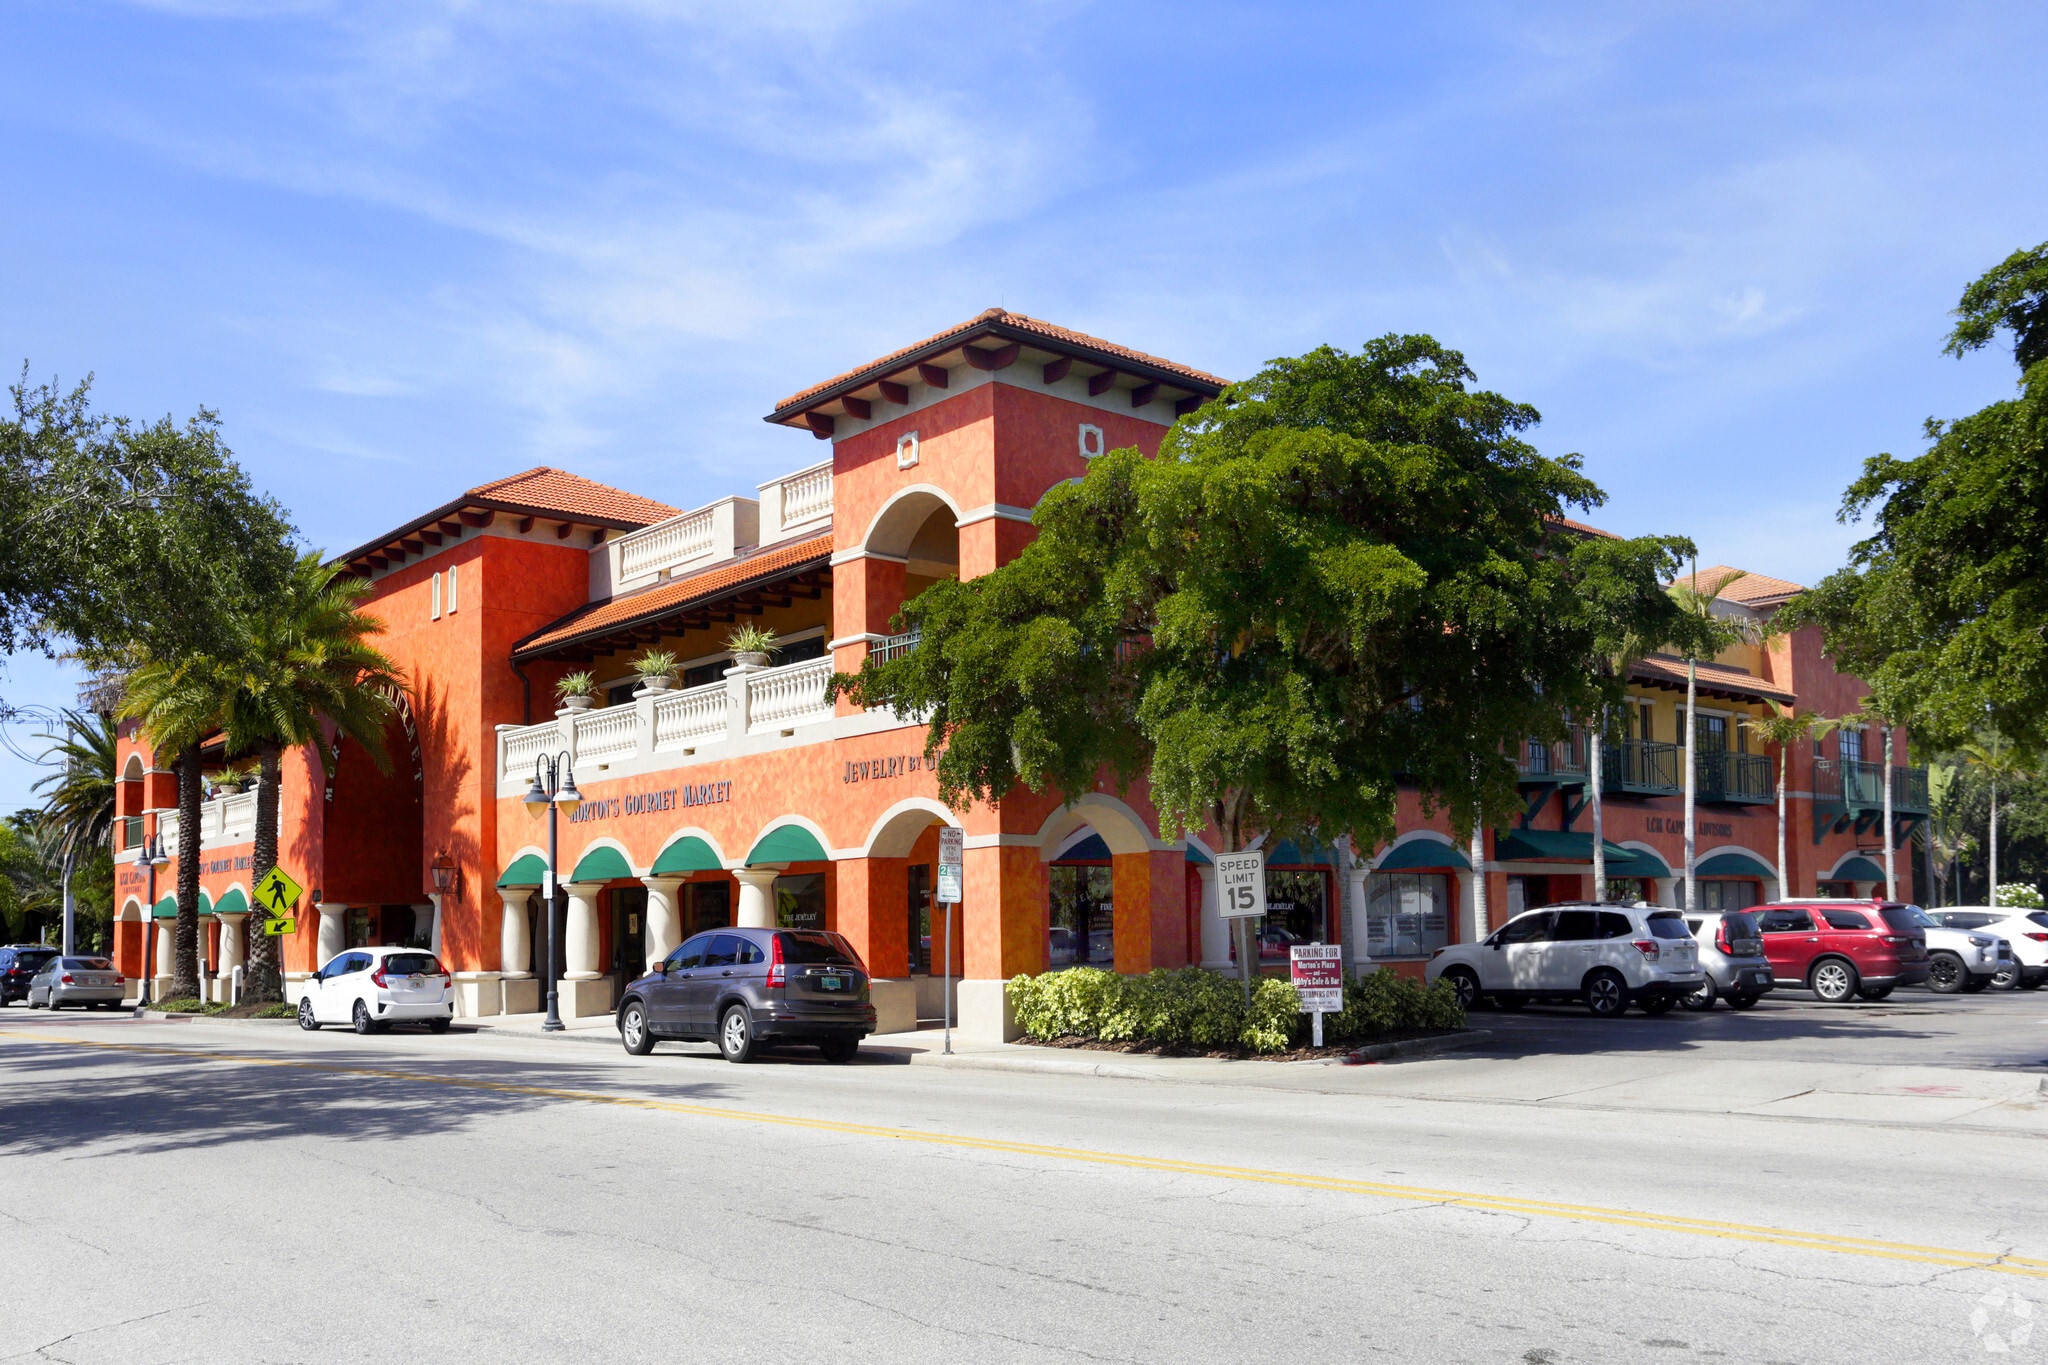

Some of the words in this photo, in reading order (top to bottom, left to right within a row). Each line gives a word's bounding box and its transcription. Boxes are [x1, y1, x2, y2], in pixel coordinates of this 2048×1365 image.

[843, 756, 905, 784] JEWELRY
[908, 756, 921, 772] BY
[624, 788, 677, 815] GOURMET
[682, 779, 732, 808] MARKET
[941, 866, 946, 874] 2
[1220, 859, 1259, 872] SPEED
[1225, 872, 1255, 884] LIMIT
[1228, 886, 1255, 909] 15
[1293, 948, 1323, 959] PARKING
[1325, 947, 1338, 958] FOR
[1297, 960, 1320, 969] Morton's
[1321, 960, 1335, 969] Plaza
[1324, 976, 1330, 985] &
[1331, 977, 1340, 985] Bar
[1326, 990, 1338, 998] ONLY
